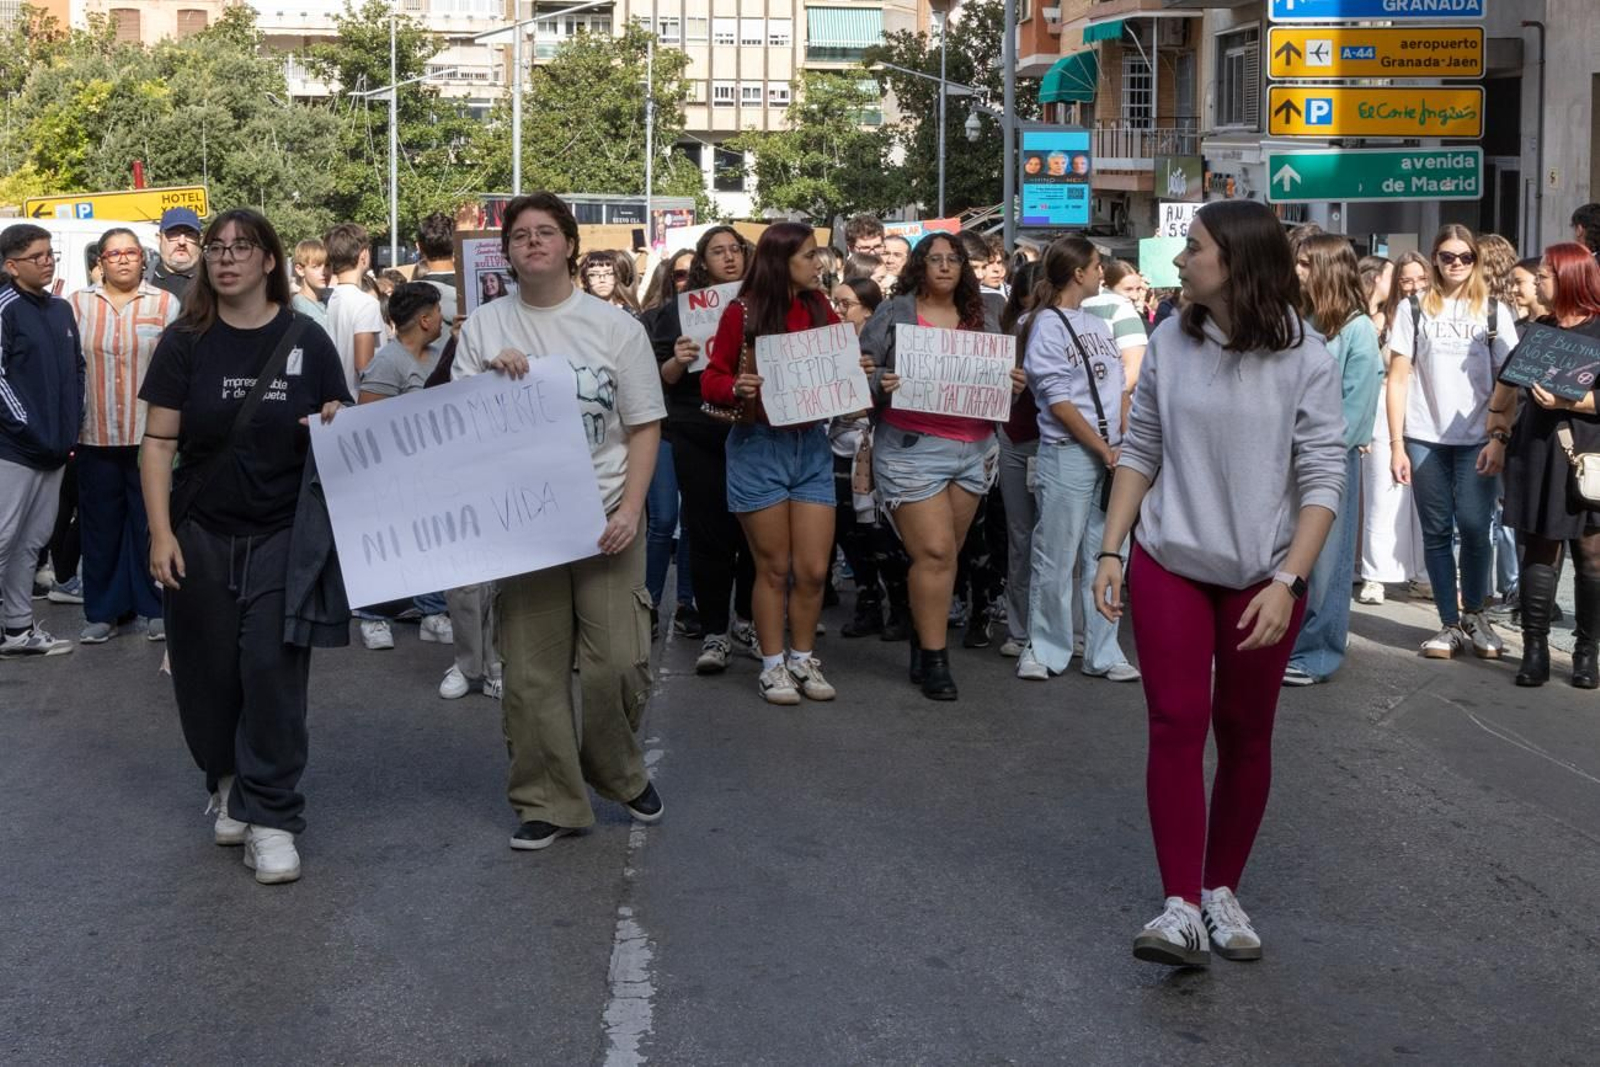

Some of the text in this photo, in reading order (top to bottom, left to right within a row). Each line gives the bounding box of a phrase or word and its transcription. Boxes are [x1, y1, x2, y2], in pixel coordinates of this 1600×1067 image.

[1382, 0, 1479, 11] GRANADA
[1400, 38, 1478, 50] aeropuerto
[1342, 48, 1374, 58] A-44
[1310, 100, 1329, 123] P
[1376, 102, 1416, 119] Corte
[1401, 154, 1475, 170] avenida
[1382, 176, 1476, 192] de Madrid
[161, 192, 203, 204] HOTEL
[78, 203, 91, 219] P
[336, 380, 559, 474] NI UNA MUERTE
[361, 481, 561, 566] NI UNA VIDA
